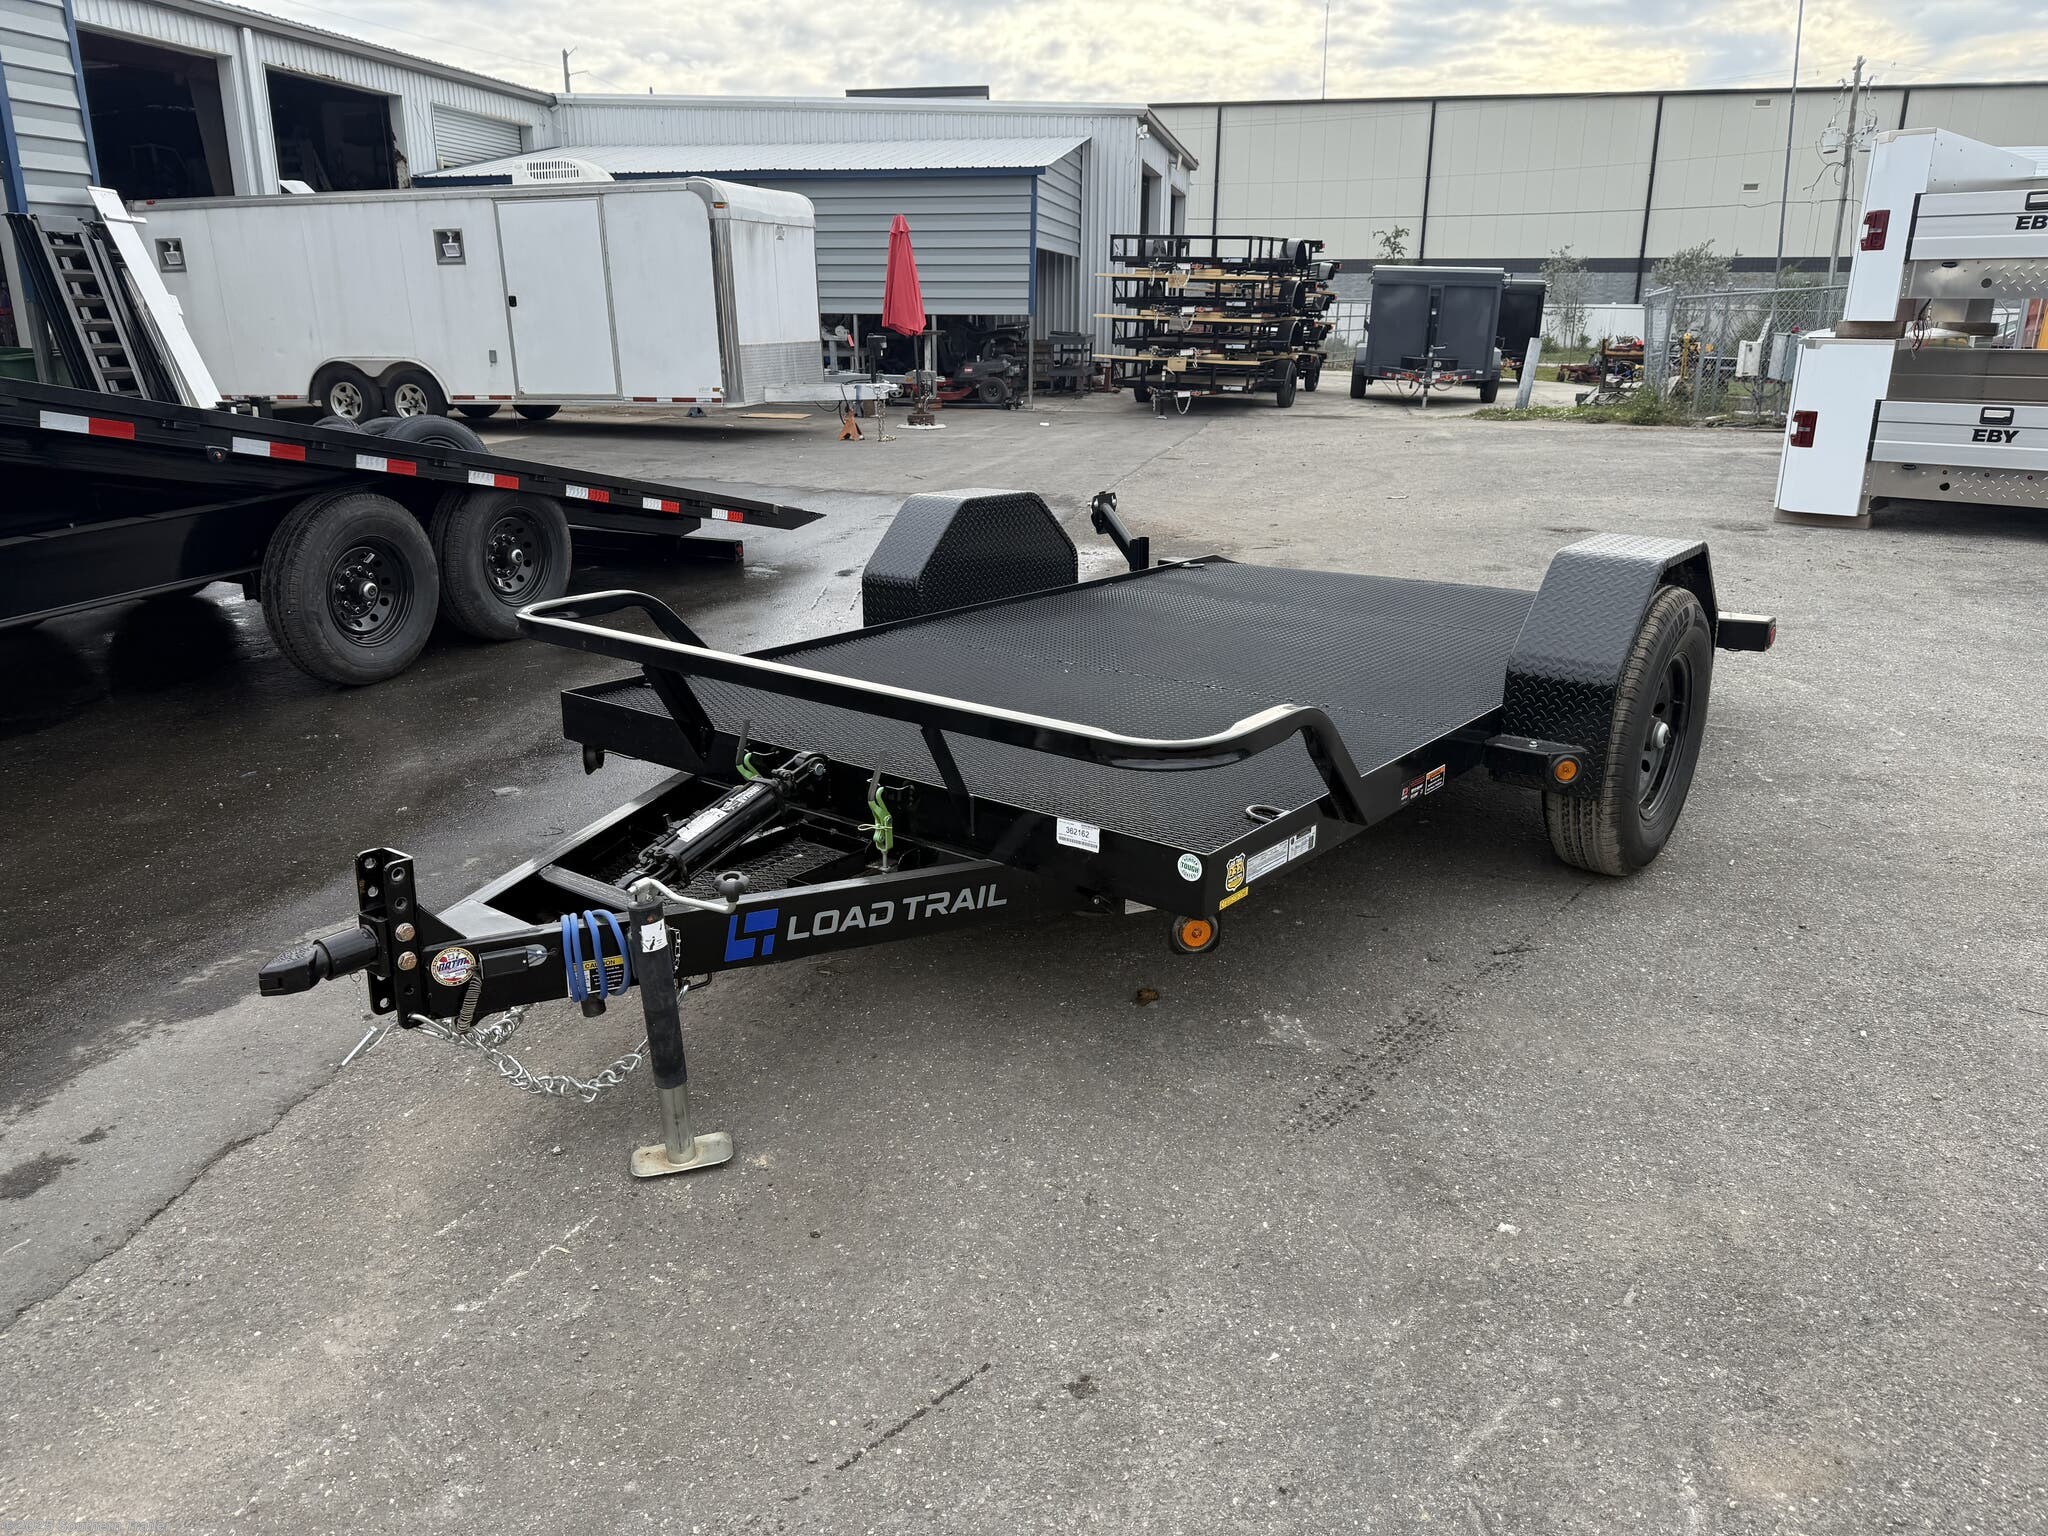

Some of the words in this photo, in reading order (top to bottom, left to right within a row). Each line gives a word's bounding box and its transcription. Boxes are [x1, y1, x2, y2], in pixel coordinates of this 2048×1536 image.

[1971, 428, 2020, 444] EBY
[787, 901, 895, 941] LOAD
[902, 883, 1007, 921] TRAIL
[584, 959, 616, 970] CAON
